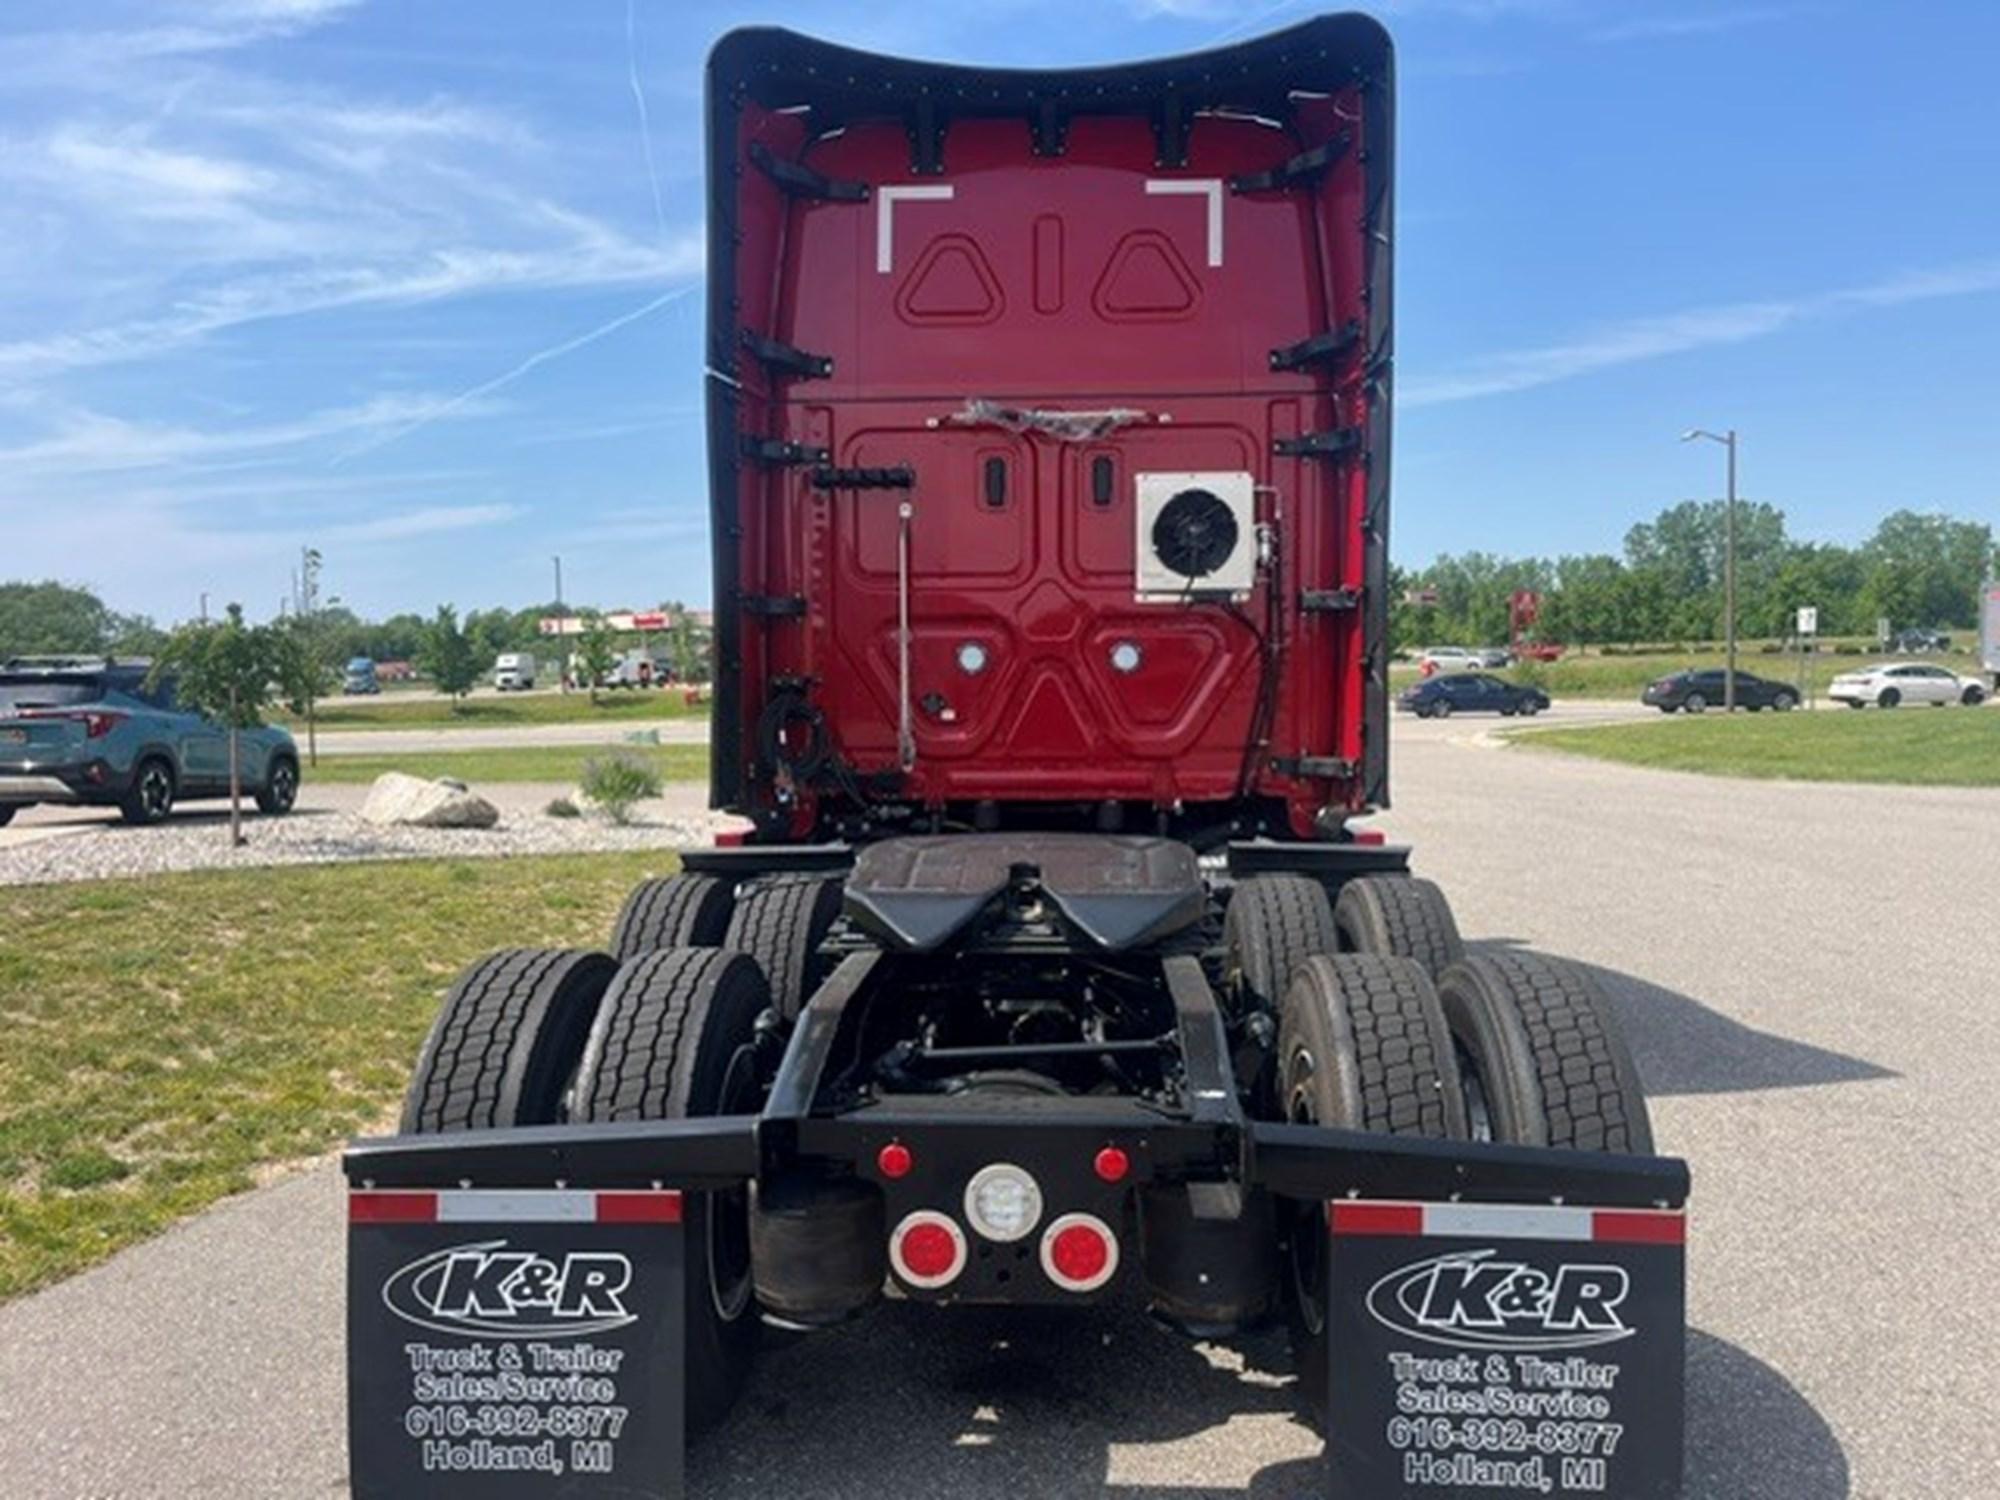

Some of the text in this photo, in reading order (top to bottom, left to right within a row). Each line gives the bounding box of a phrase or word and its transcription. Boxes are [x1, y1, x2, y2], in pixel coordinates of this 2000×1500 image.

[433, 1252, 632, 1317] K&R
[1417, 1262, 1630, 1330] K&R
[405, 1343, 624, 1371] Truck & Trailer
[1388, 1352, 1620, 1388] Truck & Trailer
[413, 1371, 616, 1402] Sales/Service
[1396, 1382, 1610, 1418] Sales/Service
[405, 1405, 629, 1438] 616-392-8377
[1386, 1417, 1624, 1455] 616-392-8377
[423, 1440, 614, 1475] Holland, MI
[1404, 1452, 1607, 1492] Holland, MI
